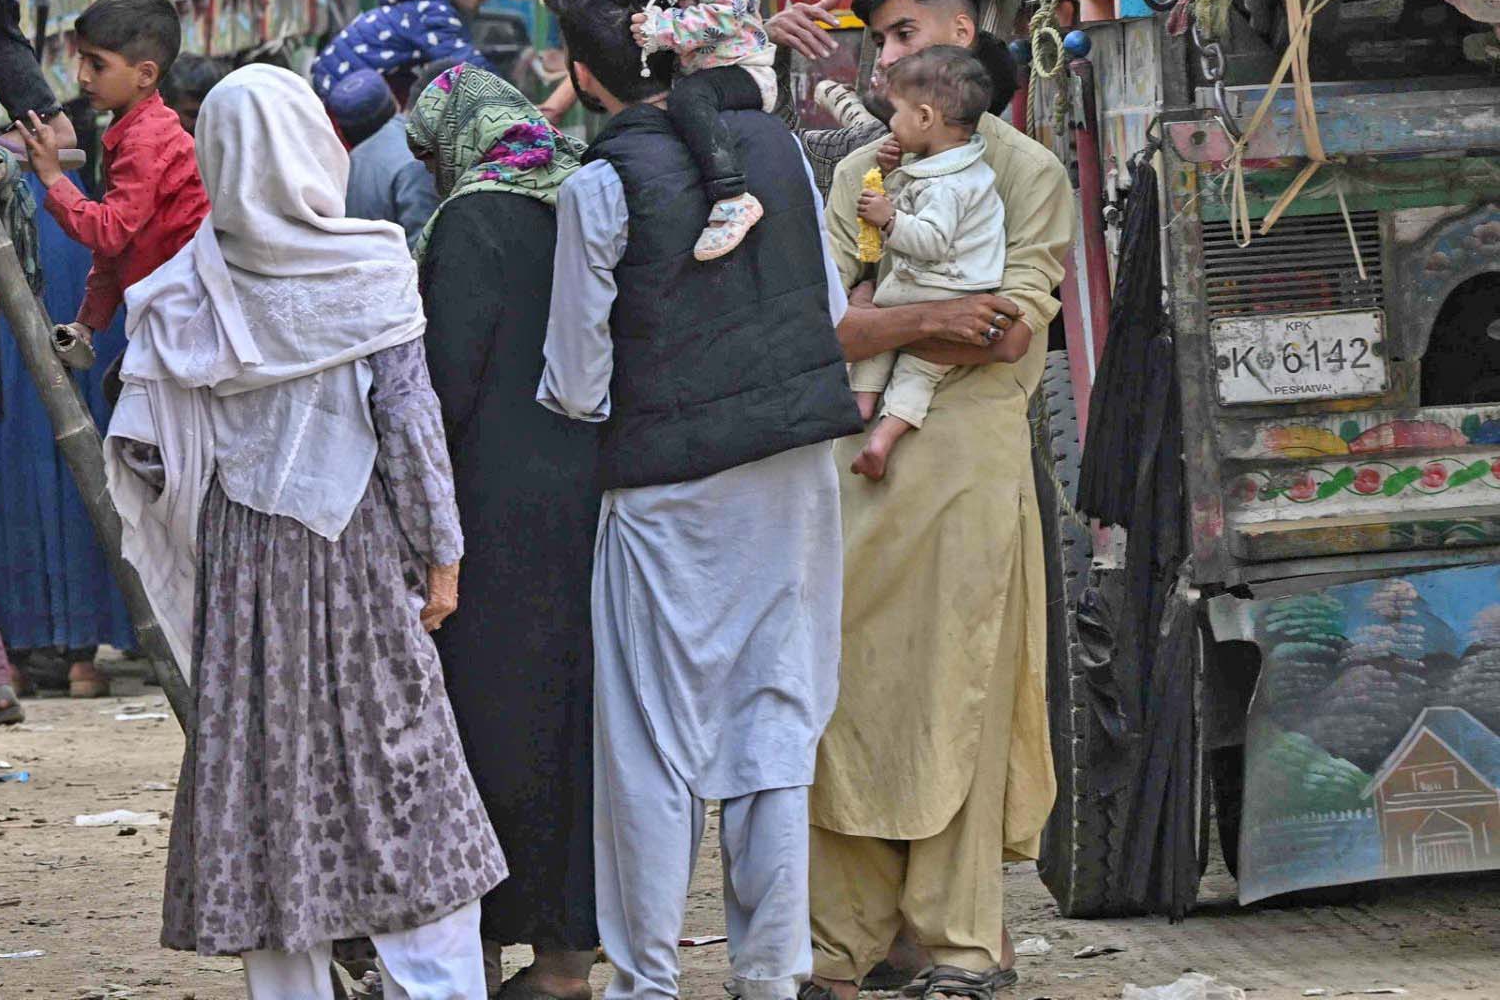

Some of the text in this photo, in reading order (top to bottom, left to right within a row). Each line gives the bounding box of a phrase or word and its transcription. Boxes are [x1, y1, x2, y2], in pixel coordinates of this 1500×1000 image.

[1286, 321, 1312, 331] KPK
[1282, 337, 1371, 374] 6142
[1274, 382, 1333, 396] PESHAWA
